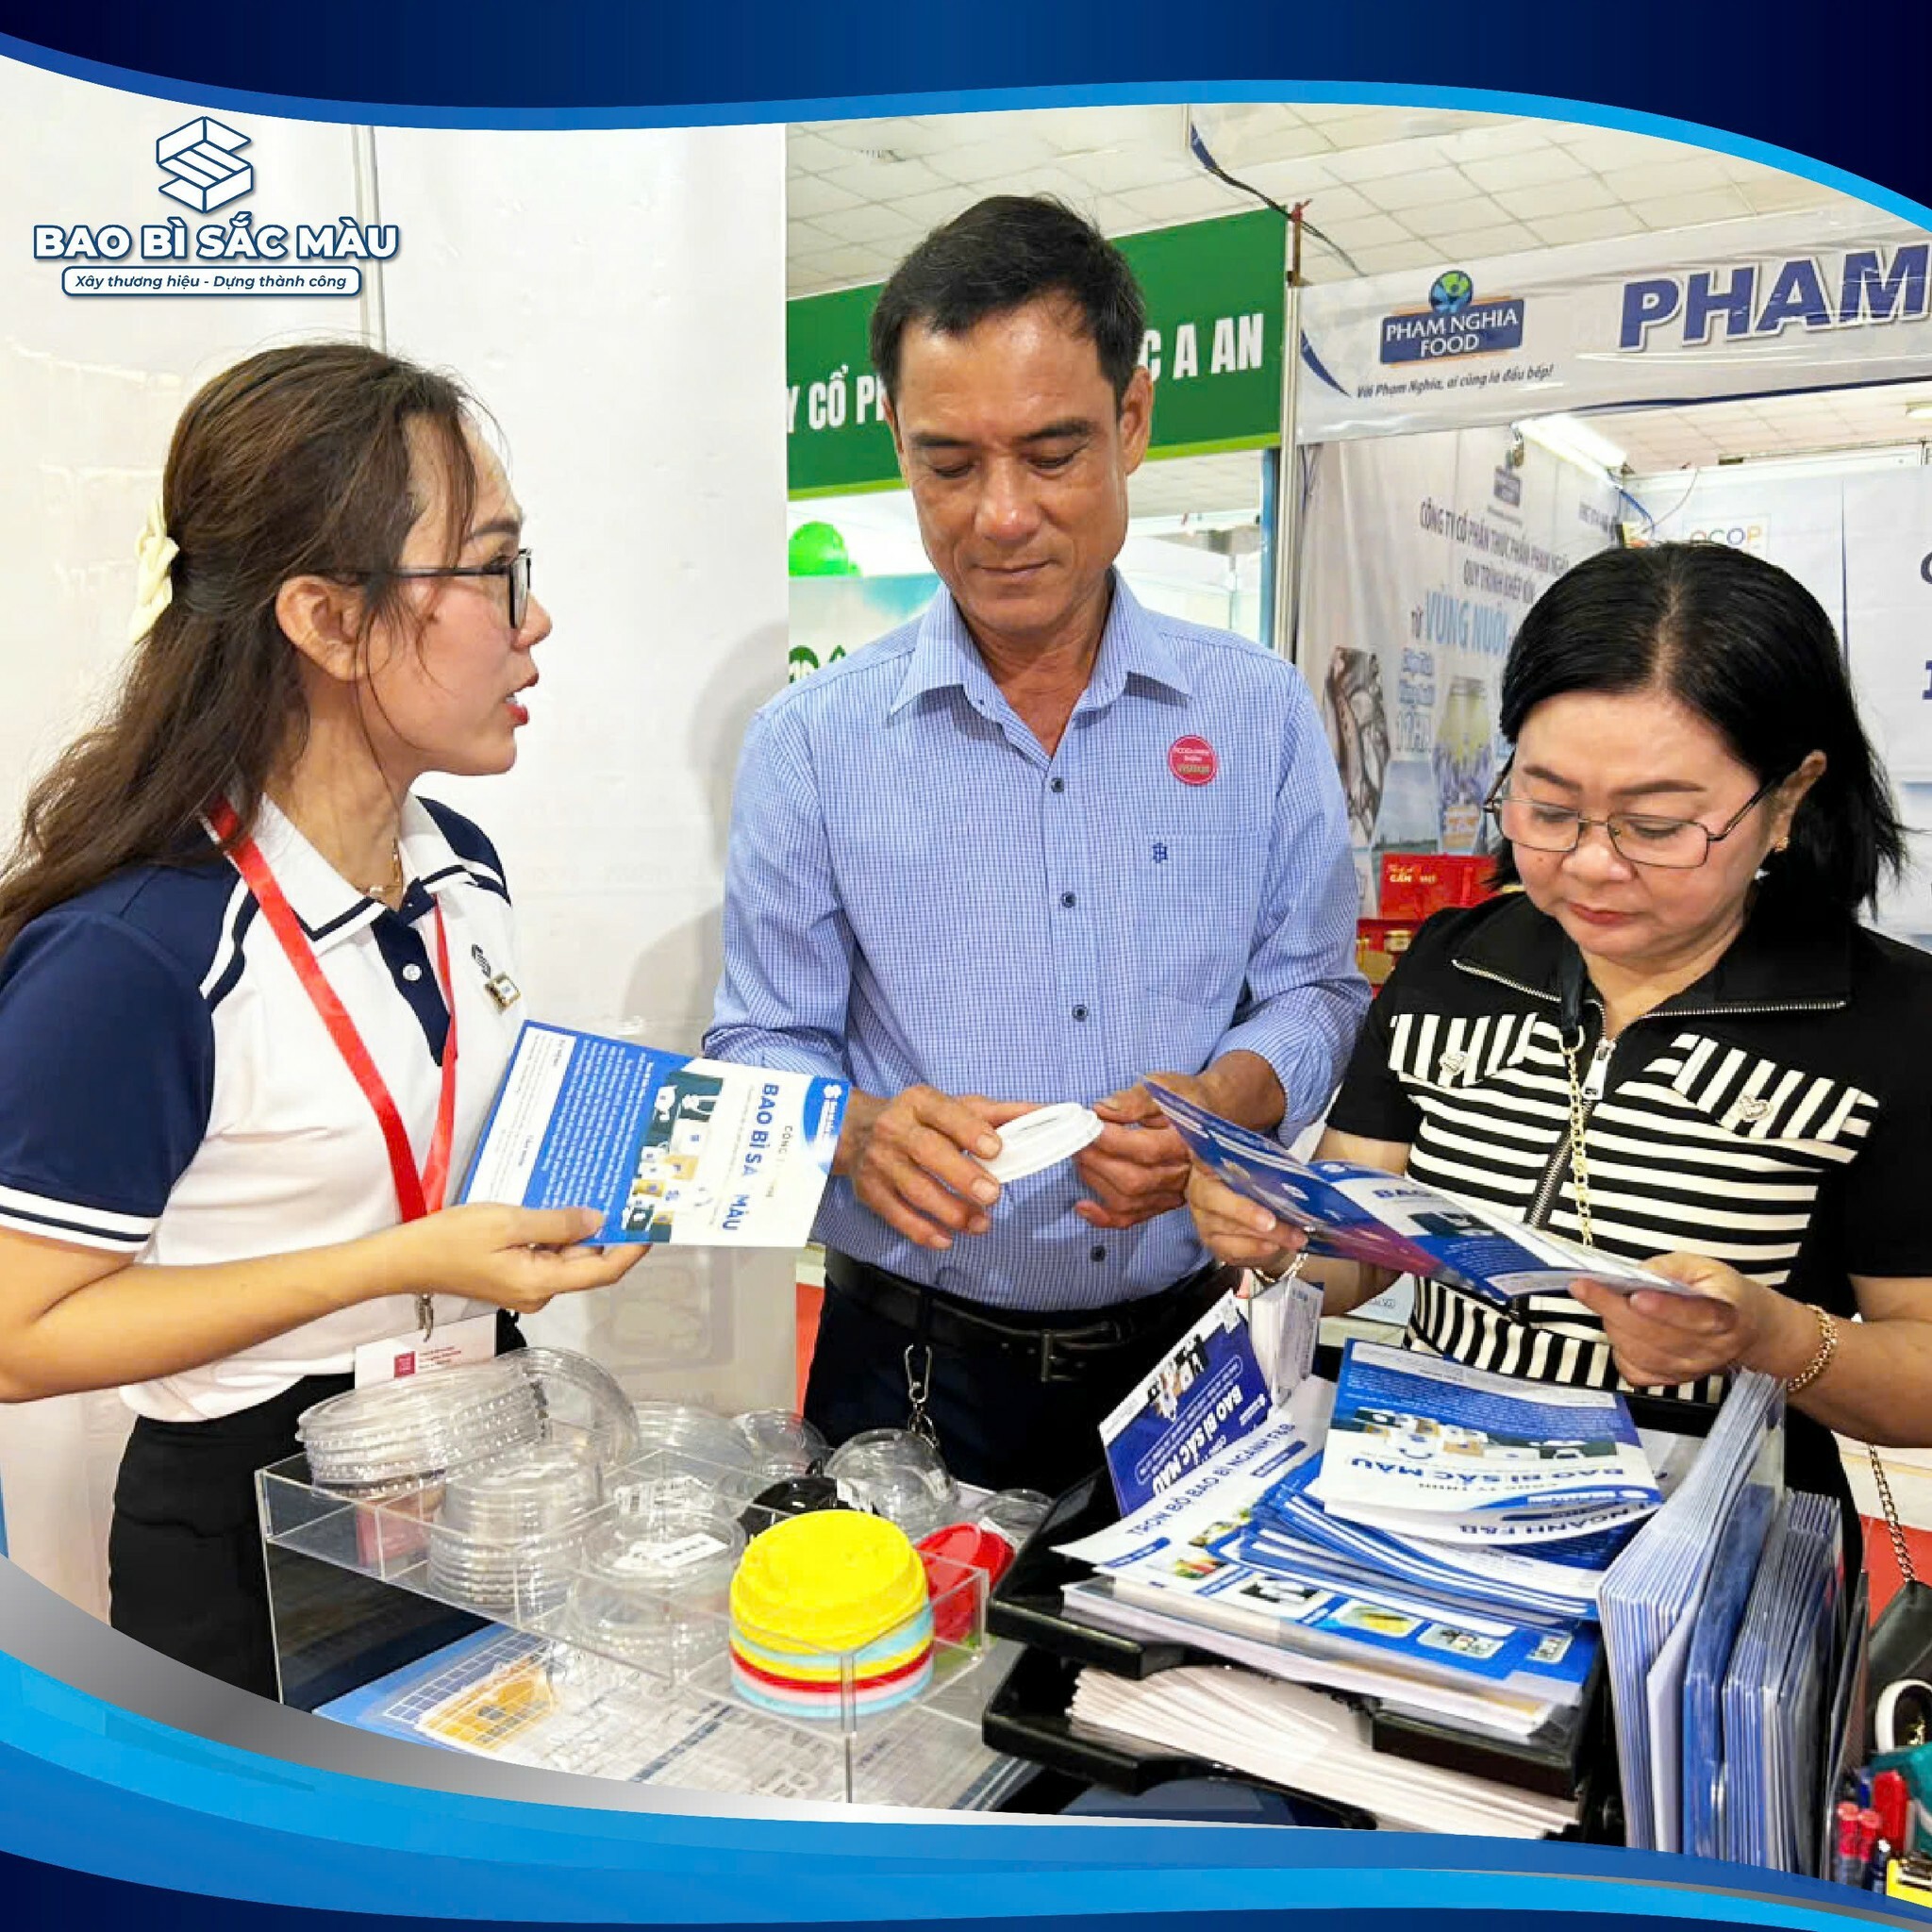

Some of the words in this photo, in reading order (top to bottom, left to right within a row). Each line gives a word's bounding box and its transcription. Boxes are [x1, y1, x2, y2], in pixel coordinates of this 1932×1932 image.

[1618, 242, 1931, 351] PHAM
[1174, 323, 1198, 380] A
[1210, 312, 1264, 375] AN
[1386, 316, 1446, 342] PHAM
[1450, 308, 1520, 334] NGHIA
[1420, 333, 1480, 358] FOOD
[808, 362, 849, 430] CỔ
[757, 1082, 780, 1125] BAO
[1350, 1457, 1424, 1477] MÀU
